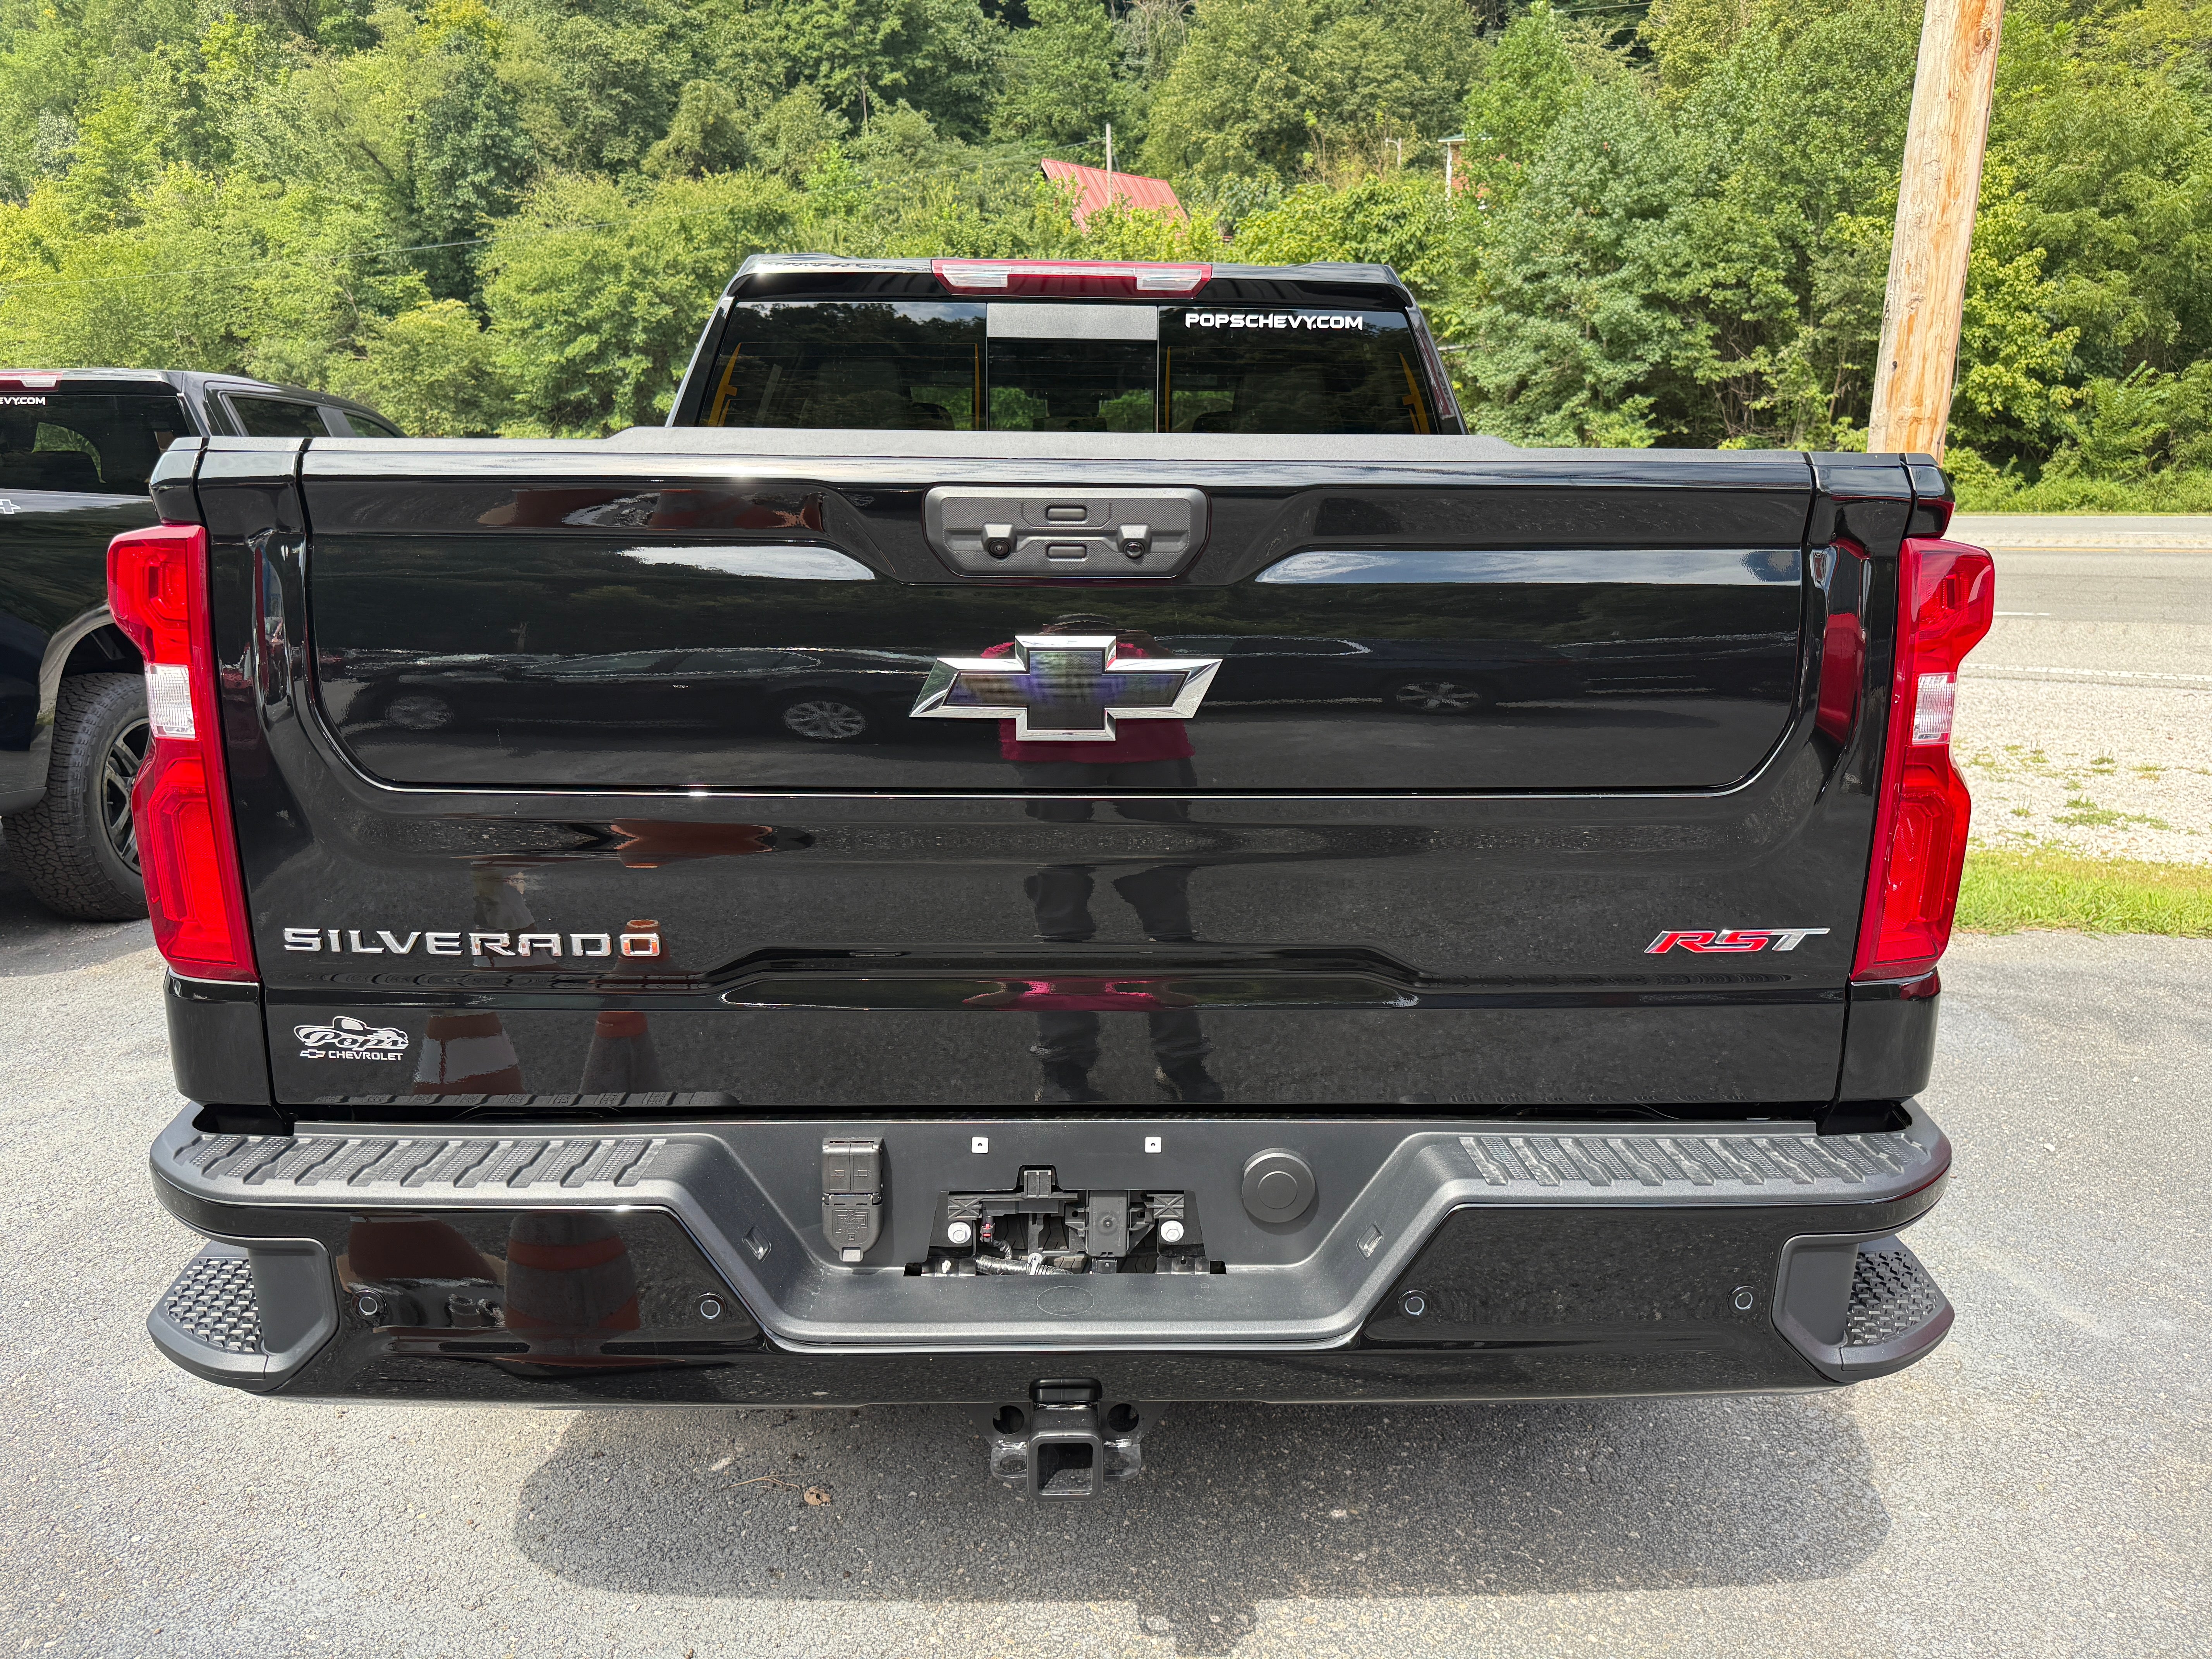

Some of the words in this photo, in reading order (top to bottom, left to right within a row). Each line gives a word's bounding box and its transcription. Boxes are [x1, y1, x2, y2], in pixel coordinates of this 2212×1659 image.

[1185, 313, 1363, 330] POPSCHEVY.COM
[284, 928, 662, 957] SILVERADO
[1644, 928, 1831, 953] RST
[328, 1051, 403, 1061] CHEVROLET
